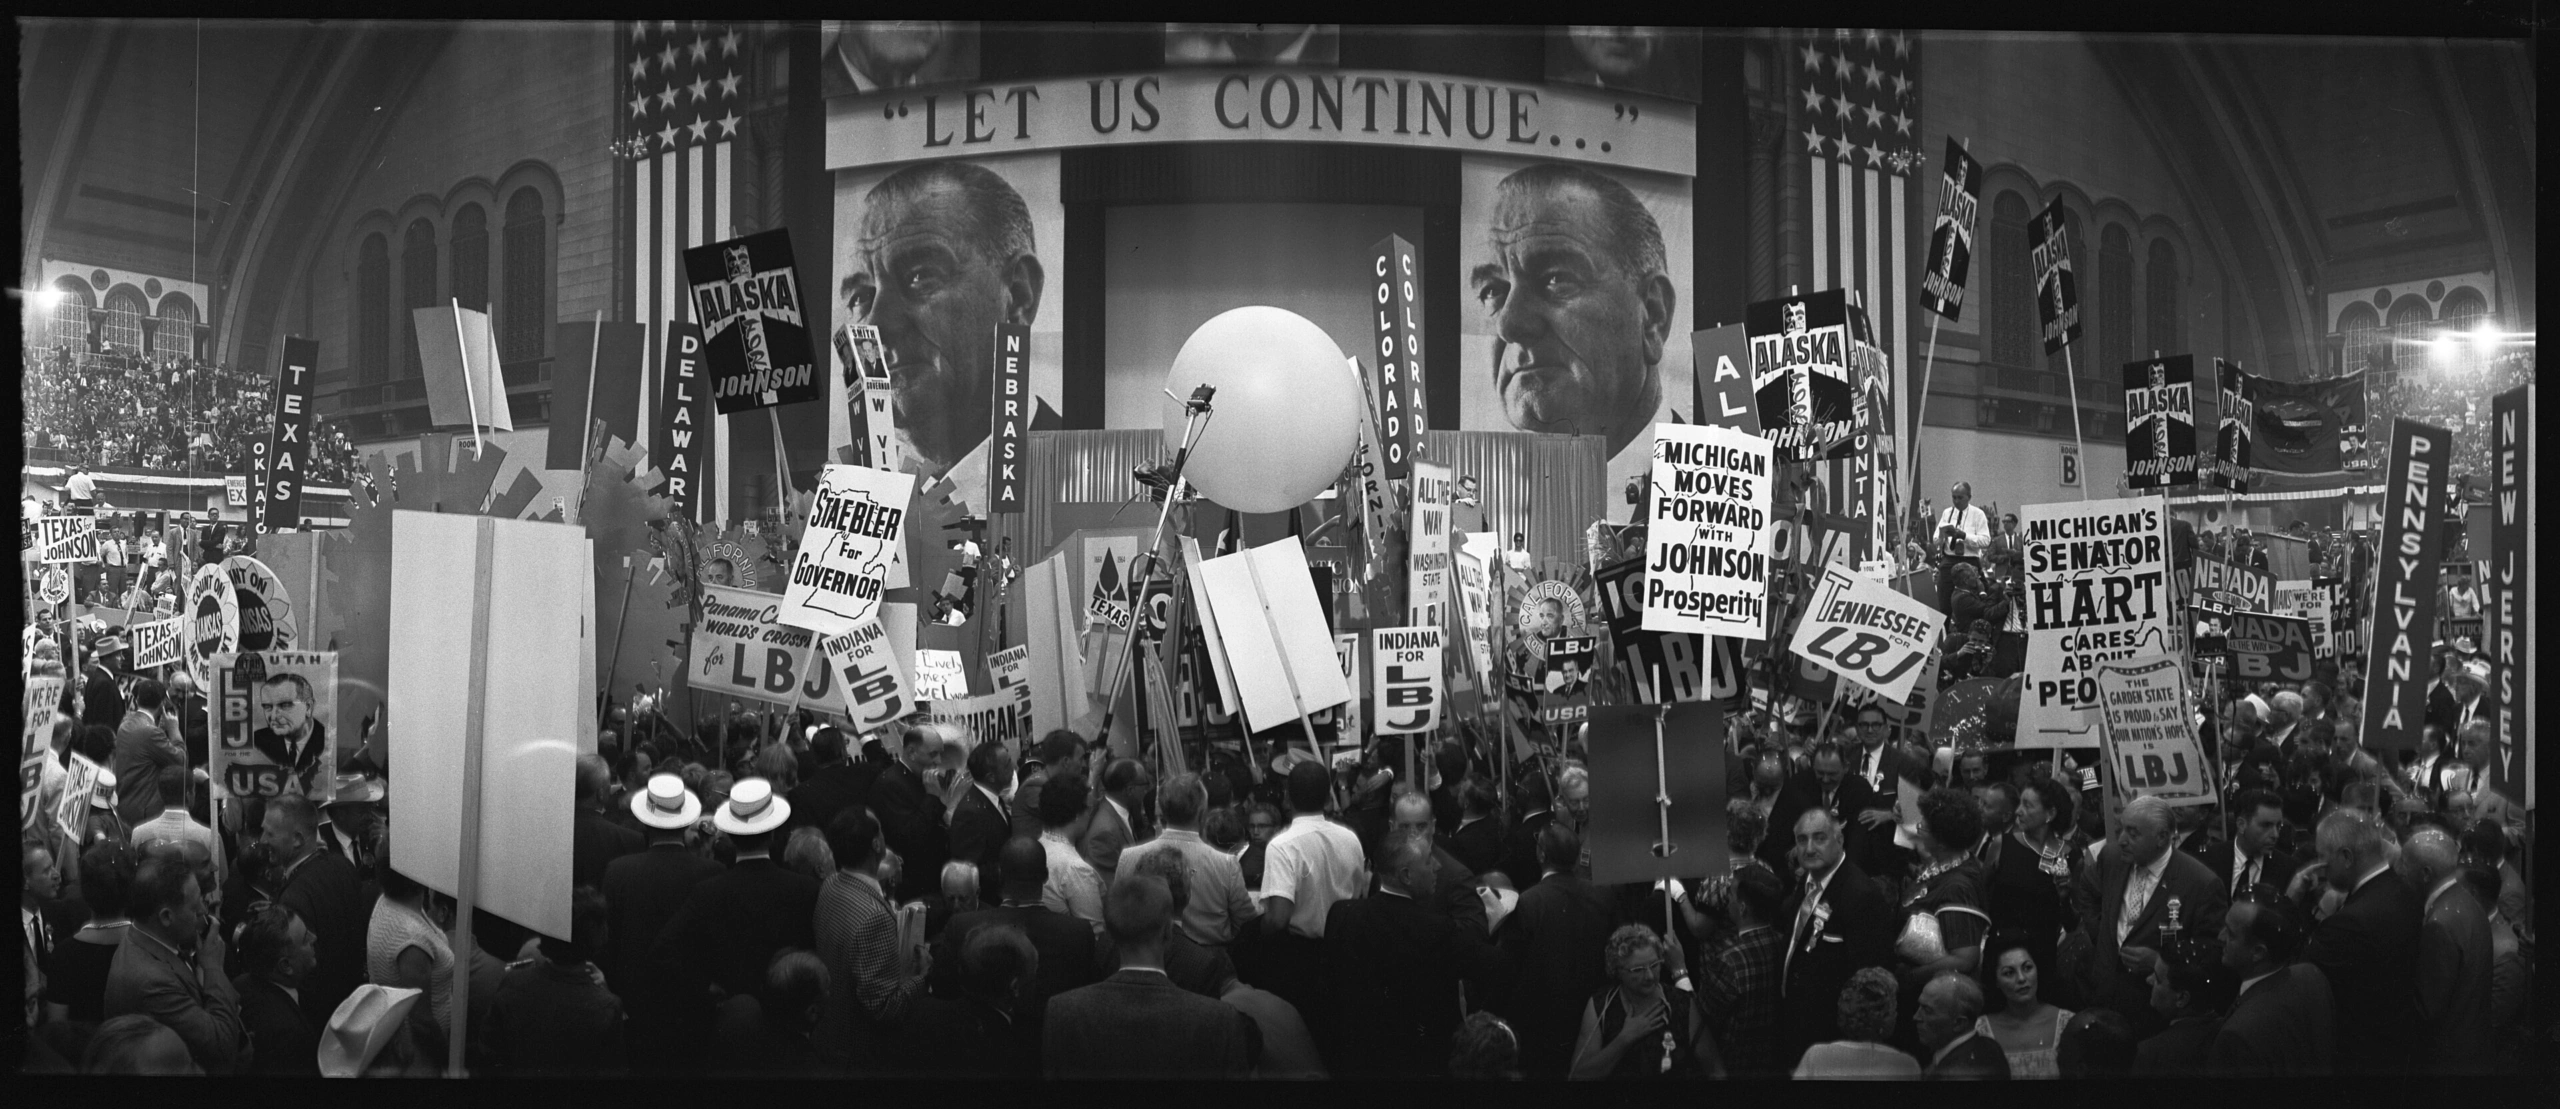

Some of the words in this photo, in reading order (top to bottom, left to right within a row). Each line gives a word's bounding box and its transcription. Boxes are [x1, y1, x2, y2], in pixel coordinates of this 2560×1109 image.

[1087, 75, 1160, 135] US
[1939, 175, 1976, 237] ALASKA
[2034, 227, 2070, 284] ALASKA
[700, 273, 796, 330] ALASKA
[1923, 269, 1965, 307] JOHNSON
[851, 328, 876, 339] SMITH
[2044, 303, 2078, 343] JOHNSON
[1376, 255, 1402, 464] COLORADO
[1755, 330, 1844, 380] ALASKA
[715, 363, 812, 399] JOHNSON
[866, 381, 890, 391] GOVERNOR
[872, 398, 885, 413] W
[1001, 335, 1020, 501] NEBRASKA
[2128, 386, 2192, 423] ALASKA
[2221, 391, 2251, 430] ALASKA
[274, 365, 306, 501] TEXAS
[2340, 425, 2365, 434] LBJ
[1664, 441, 1766, 477] MICHIGAN
[2060, 445, 2079, 456] ROOM
[2128, 454, 2197, 477] JOHNSON
[2342, 459, 2368, 468] USA
[2063, 454, 2077, 484] B
[2215, 459, 2250, 484] JOHNSON
[2500, 409, 2517, 526] NEW
[1417, 476, 1436, 504] ALL
[1437, 479, 1450, 506] THE
[1674, 470, 1753, 501] MOVES
[810, 487, 902, 542] STAEBLER
[1423, 509, 1443, 536] WAY
[1658, 497, 1764, 532] FORWARD
[2030, 508, 2158, 541] MICHIGAN'S
[41, 518, 82, 546] TEXAS
[44, 529, 97, 561] JOHNSON
[1699, 528, 1733, 543] WITH
[839, 542, 862, 560] For
[1413, 552, 1448, 572] WASHINGTON
[1650, 542, 1765, 583] JOHNSON
[2029, 535, 2162, 573] SENATOR
[193, 574, 214, 606] COUNT
[214, 577, 226, 600] ON
[250, 572, 268, 596] ON
[793, 551, 882, 602] GOVERNOR
[1422, 573, 1441, 587] STATE
[1461, 564, 1475, 588] ALL
[2193, 556, 2270, 614] NEVADA
[2382, 434, 2431, 732] PENNSYLVANIA
[702, 594, 761, 622] Panama
[1520, 581, 1585, 630] CALIFORNIA
[1649, 578, 1763, 628] Prosperity
[1815, 569, 1931, 644] TENNESSEE
[2030, 571, 2163, 631] HART
[2201, 599, 2234, 616] LBJ
[2293, 591, 2326, 602] WE'RE
[2300, 601, 2322, 609] FOR
[1090, 596, 1130, 629] TEXAS
[135, 622, 171, 653] TEXAS
[705, 618, 760, 640] WORLD'S
[826, 622, 884, 657] INDIANA
[1378, 630, 1440, 651] INDIANA
[1888, 634, 1911, 649] FOR
[2060, 629, 2136, 652] CARES
[136, 631, 182, 667] JOHNSON
[269, 654, 321, 666] UTAH
[847, 644, 874, 663] FOR
[989, 647, 1028, 669] INDIANA
[1396, 651, 1425, 663] FOR
[1550, 639, 1594, 656] LBJ
[1806, 625, 1926, 685] LBJ
[703, 645, 724, 676] for
[732, 642, 832, 700] LBJ
[1002, 663, 1020, 674] FOR
[2500, 551, 2515, 783] JERSEY
[31, 683, 60, 709] WE'RE
[843, 663, 902, 724] LBJ
[1386, 665, 1434, 731] LBJ
[2109, 689, 2144, 706] GARDEN
[2145, 686, 2175, 704] STATE
[2125, 678, 2150, 689] THE
[32, 710, 51, 728] FOR
[224, 670, 249, 749] LBJ
[1545, 705, 1588, 721] USA
[2112, 710, 2122, 724] IS
[2124, 708, 2151, 724] PROUD
[2159, 706, 2178, 722] SAY
[2115, 728, 2131, 743] OUR
[2131, 724, 2164, 742] NATION'S
[2164, 724, 2186, 741] HOPE
[231, 771, 305, 797] USA
[2124, 752, 2189, 788] LBJ
